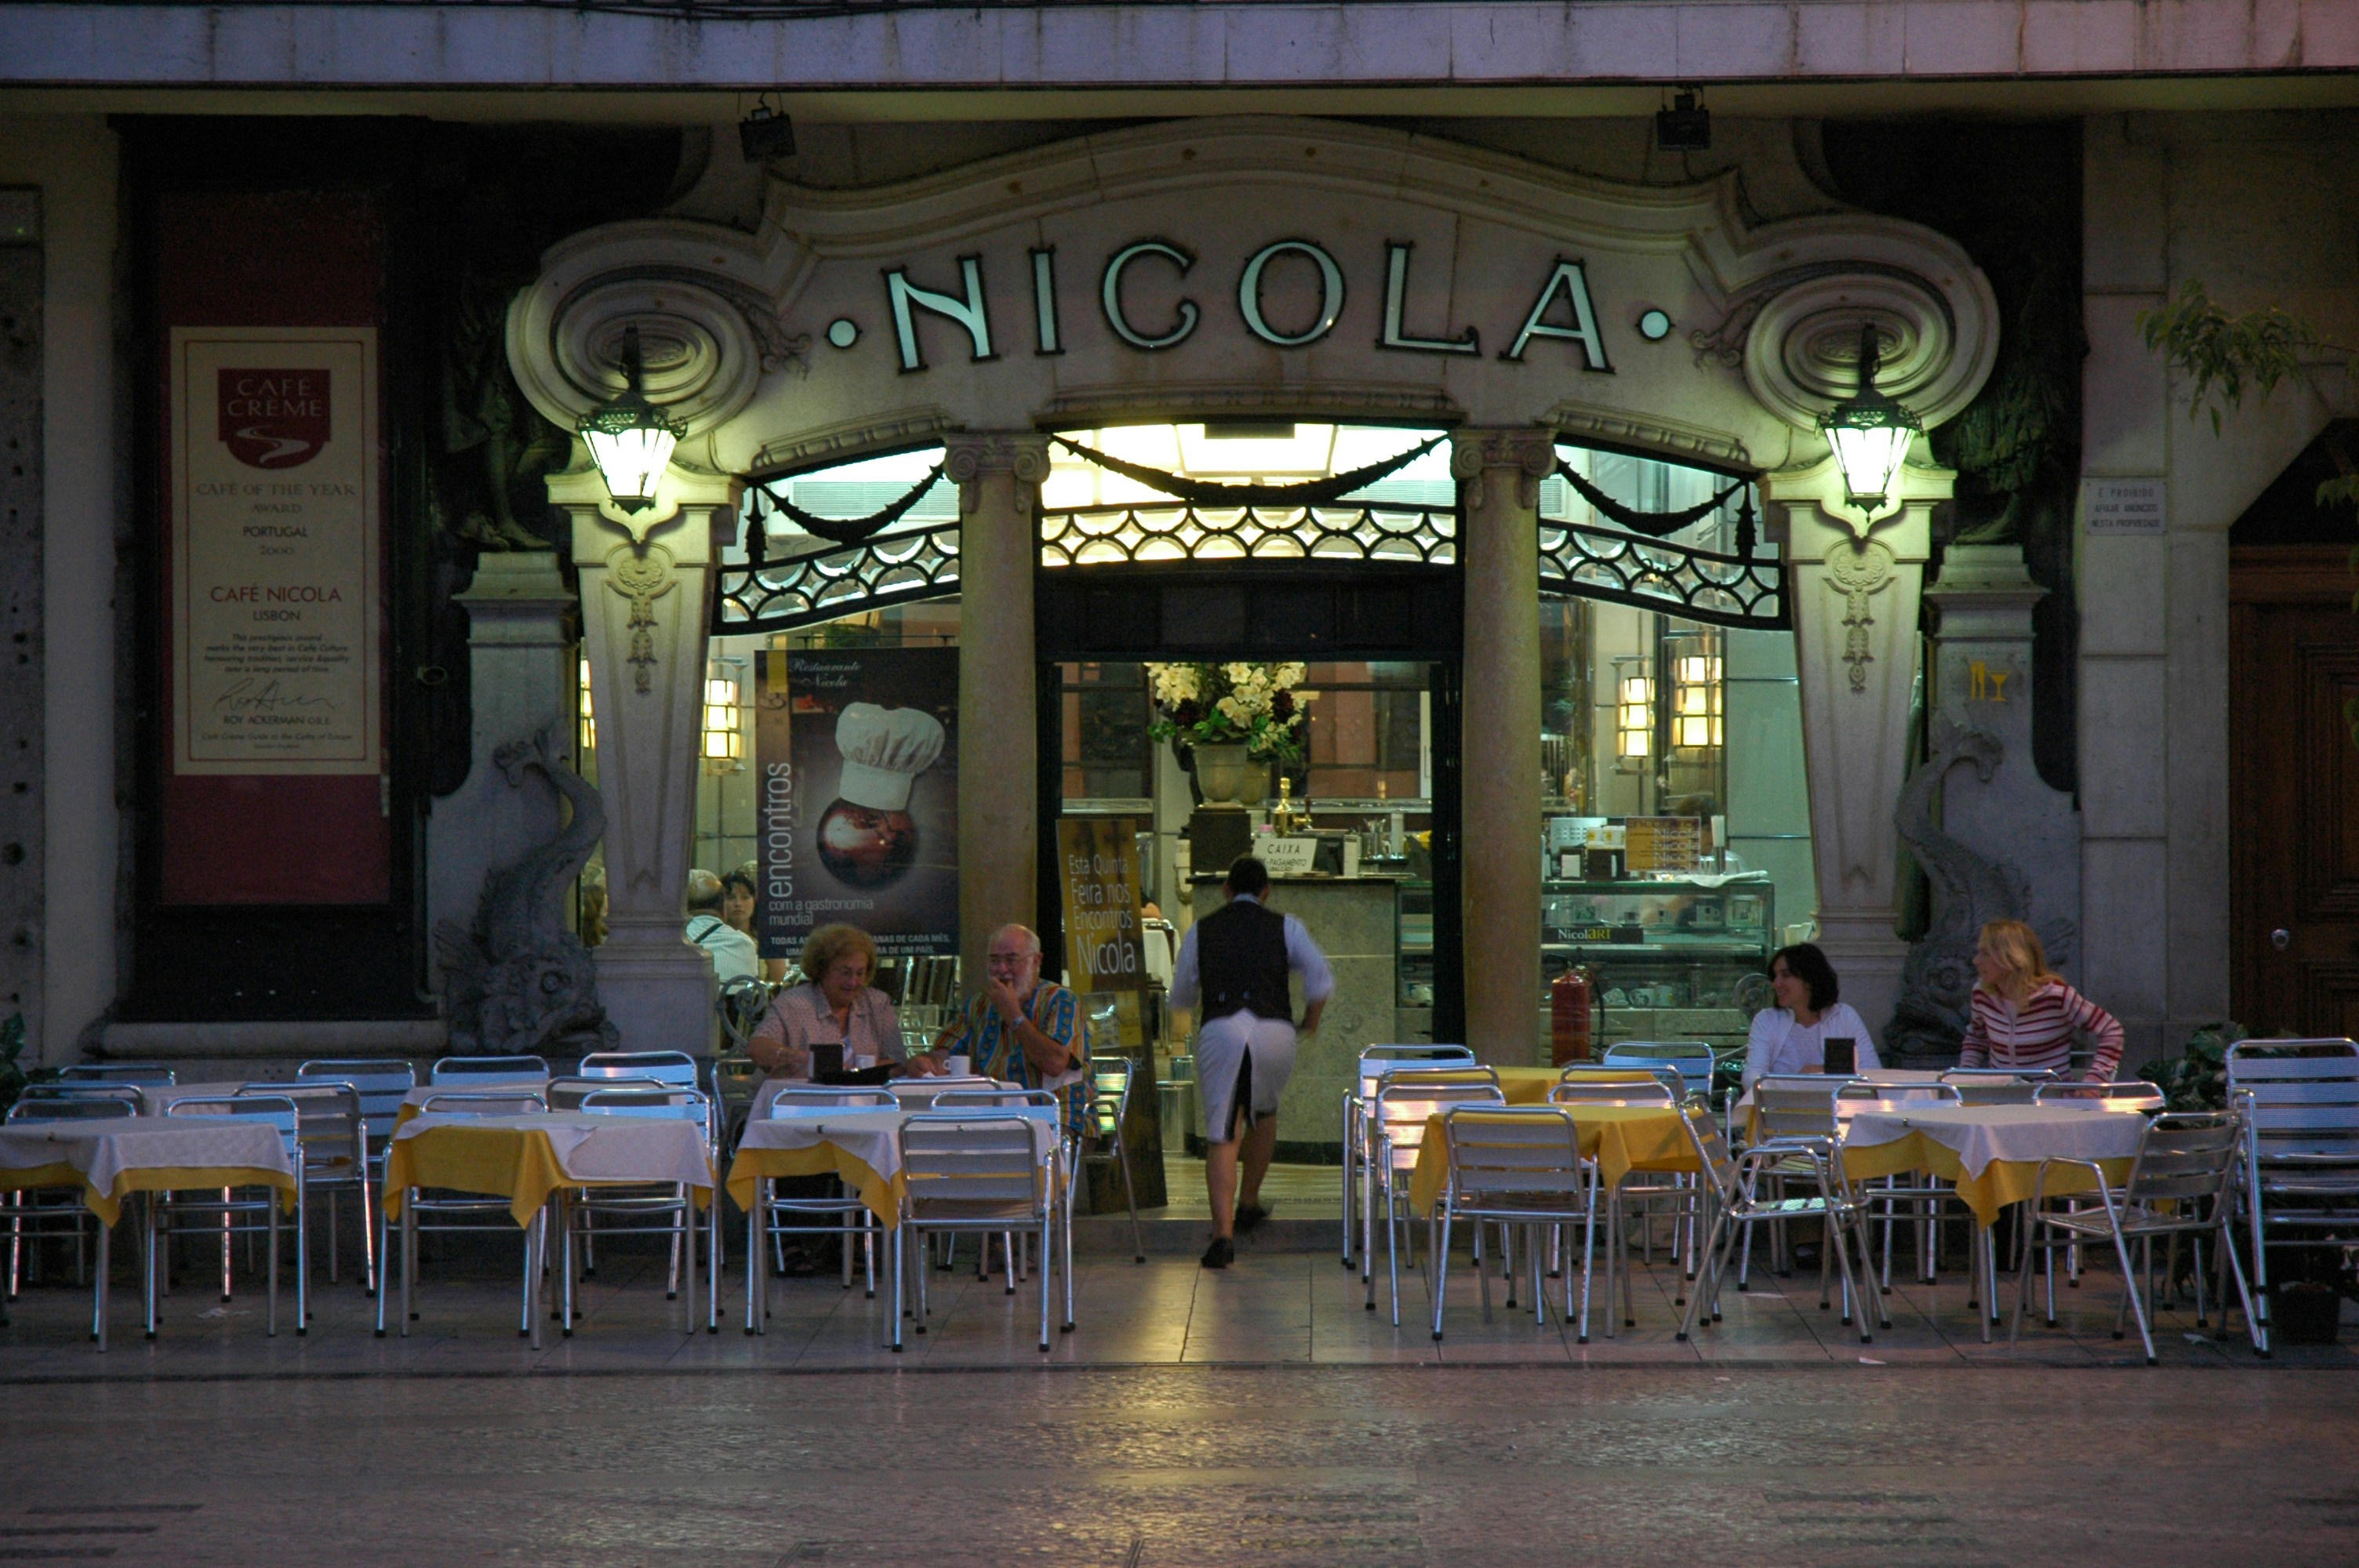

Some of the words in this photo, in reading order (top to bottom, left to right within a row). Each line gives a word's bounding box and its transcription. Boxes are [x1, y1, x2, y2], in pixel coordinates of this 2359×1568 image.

[880, 235, 1616, 375] NICOLA
[237, 376, 311, 396] CAFÉ
[227, 395, 323, 417] CRÈME
[243, 484, 264, 495] OF
[267, 484, 304, 495] THE
[311, 484, 356, 495] YEAR
[2110, 488, 2154, 498] PROIBIDO
[251, 503, 303, 514] AWARD
[2092, 519, 2114, 528] NESTA
[2116, 519, 2161, 528] PROPRIEDADE
[242, 525, 308, 538] PORTUGAL
[209, 583, 260, 603] CAFÉ
[266, 586, 342, 603] NICOLA
[253, 610, 301, 622] LISBON
[801, 673, 848, 688] Nicola
[223, 715, 244, 724] ROY
[763, 762, 793, 898] encontros
[1267, 844, 1300, 854] CAIXA
[1068, 854, 1090, 875] Esta
[1093, 854, 1129, 877] Quinta
[1070, 877, 1103, 905] Feira
[1107, 883, 1132, 904] nos
[769, 901, 794, 911] com
[795, 901, 803, 910] a
[805, 898, 874, 913] gastronomia
[769, 912, 813, 926] mundial
[1072, 906, 1133, 931] Encontros
[770, 936, 797, 946] TODAS
[896, 935, 907, 943] DE
[907, 934, 930, 943] CADA
[889, 946, 899, 955] DE
[1076, 930, 1136, 975] Nicola
